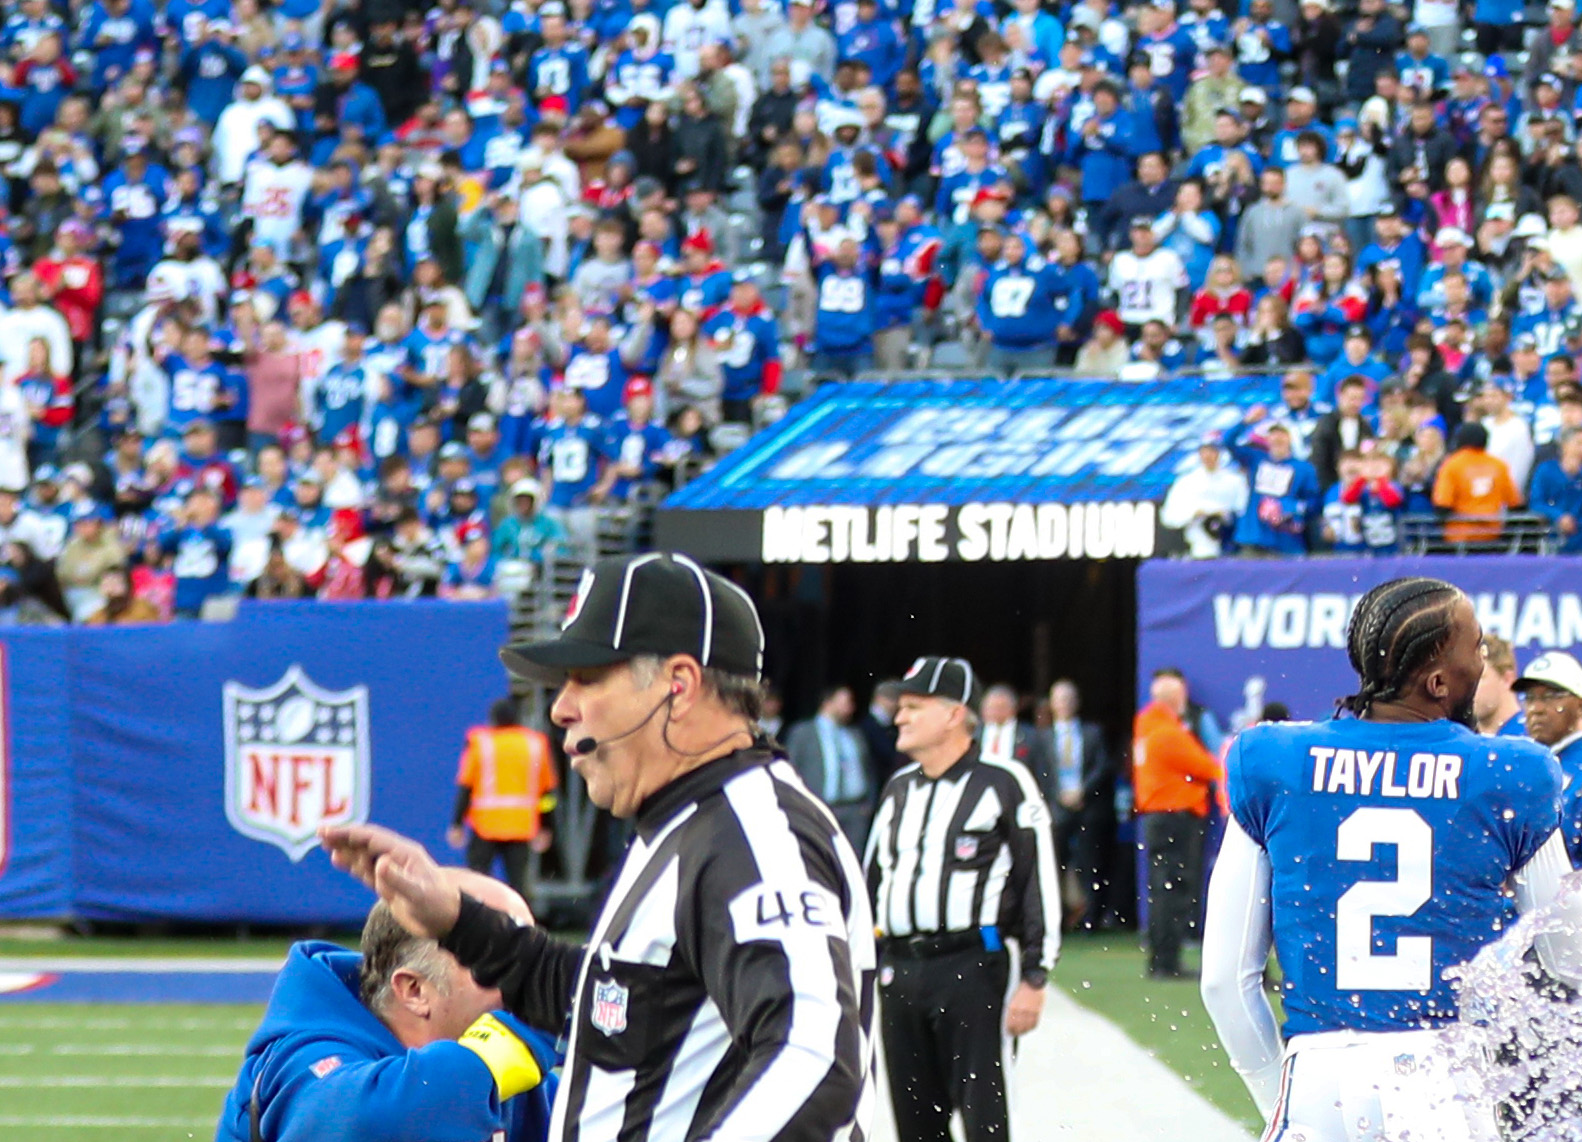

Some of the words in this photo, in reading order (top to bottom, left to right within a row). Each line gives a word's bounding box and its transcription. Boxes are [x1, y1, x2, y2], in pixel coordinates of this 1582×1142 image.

[761, 503, 949, 563] METLIFE
[956, 502, 1155, 562] STADIUM
[1213, 594, 1354, 648] WOR
[248, 753, 347, 826] NFL
[1310, 746, 1462, 799] TAYLOR
[1336, 806, 1433, 991] 2
